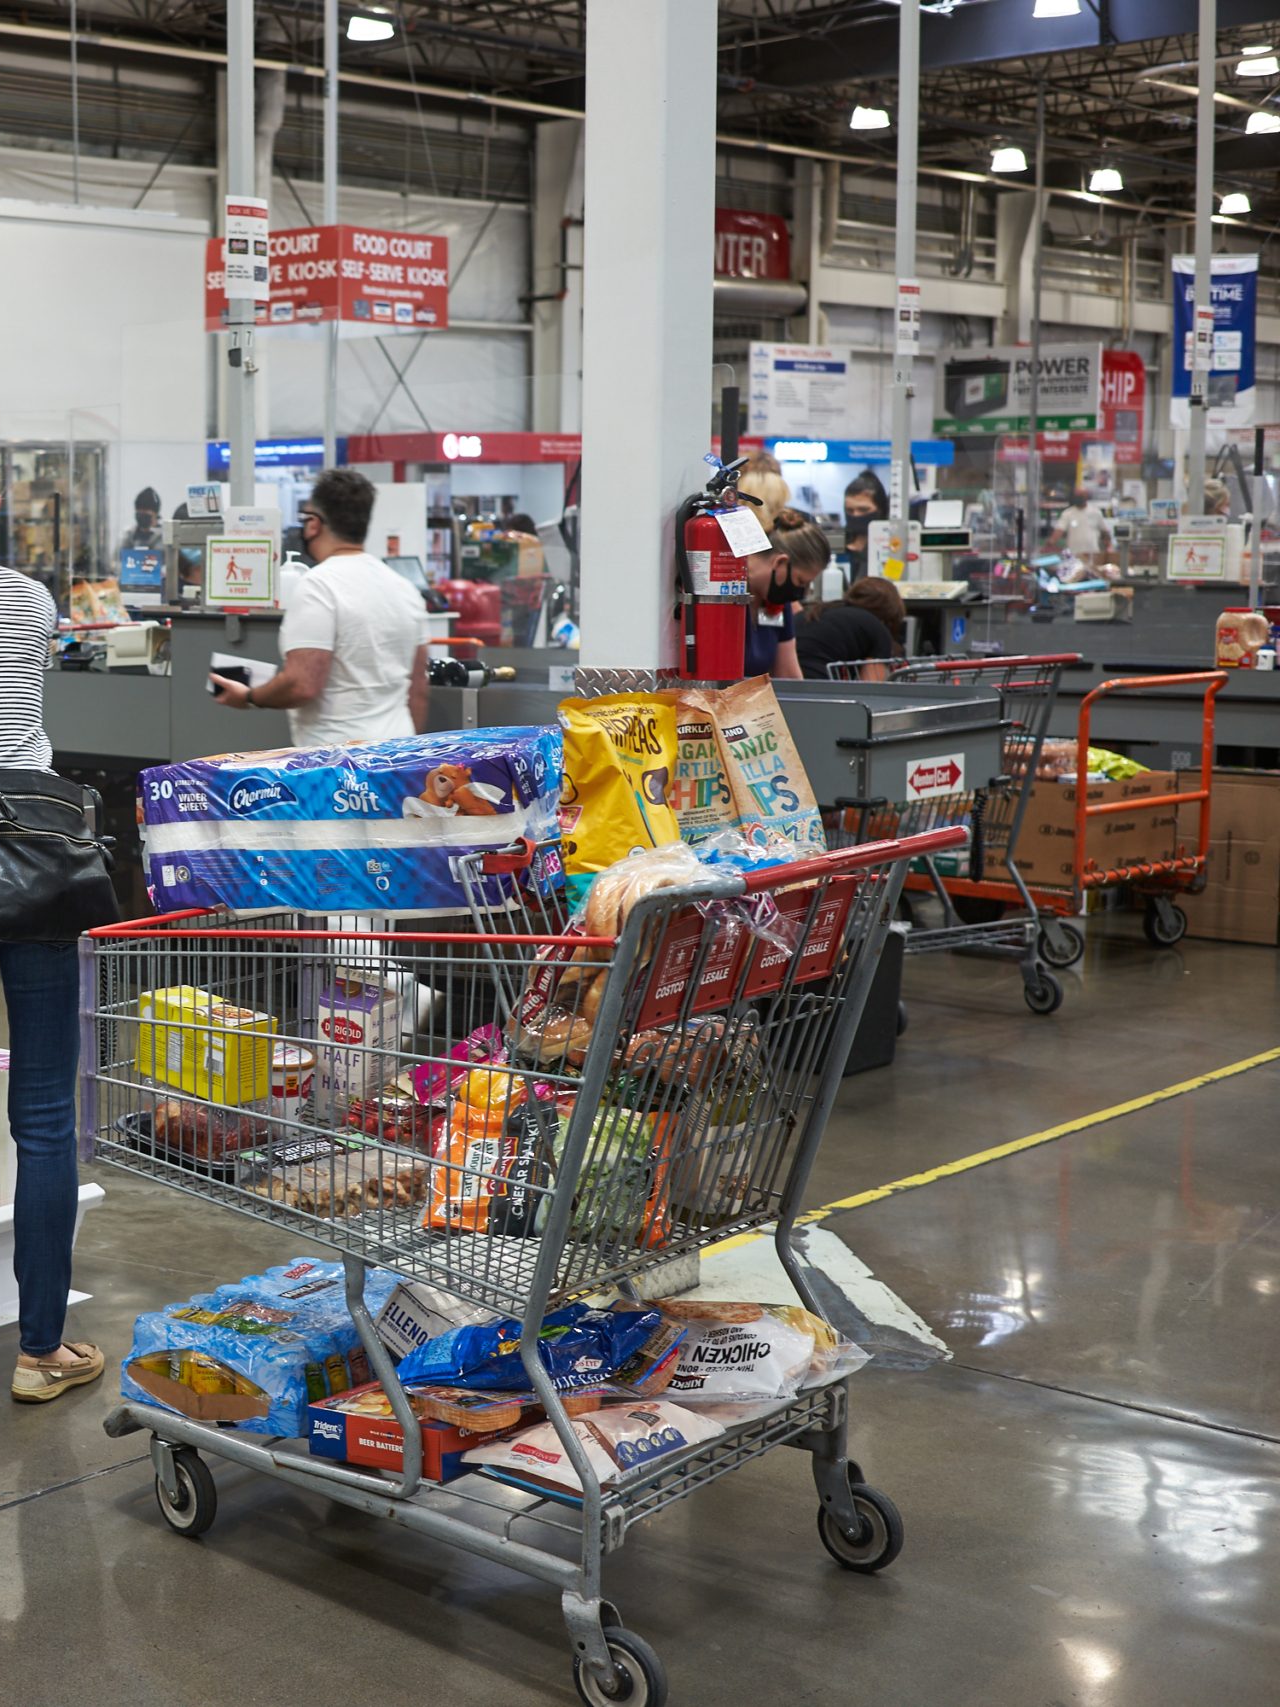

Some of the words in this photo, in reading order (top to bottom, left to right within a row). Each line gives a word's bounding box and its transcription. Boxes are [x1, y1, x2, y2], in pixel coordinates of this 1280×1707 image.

[269, 234, 320, 257] COURT
[353, 233, 387, 256] FOOD
[390, 240, 433, 260] COURT
[288, 260, 337, 281] KIOSK
[341, 259, 403, 283] SELF-SERVE
[407, 268, 446, 287] KIOSK
[1212, 288, 1243, 301] TIME
[1015, 358, 1090, 375] POWER
[1103, 370, 1135, 404] HIP
[913, 768, 935, 786] Member
[936, 765, 950, 782] Cart
[150, 780, 172, 801] 30
[178, 792, 207, 802] WIDER
[233, 783, 282, 809] Charmin
[178, 802, 208, 812] SHEETS
[333, 789, 380, 813] Soft
[656, 981, 684, 999] COSTCO
[324, 1023, 362, 1039] DRIGOLD
[511, 1169, 528, 1216] CAESAR
[385, 1301, 429, 1344] ELLENO
[708, 1327, 730, 1337] KOSHER
[729, 1333, 757, 1343] CONTAINS
[692, 1342, 771, 1364] CHICKEN
[677, 1364, 699, 1373] BONE
[739, 1364, 755, 1373] THIN
[313, 1419, 338, 1431] Trident
[359, 1437, 375, 1449] BEER
[376, 1440, 404, 1454] BATTERE
